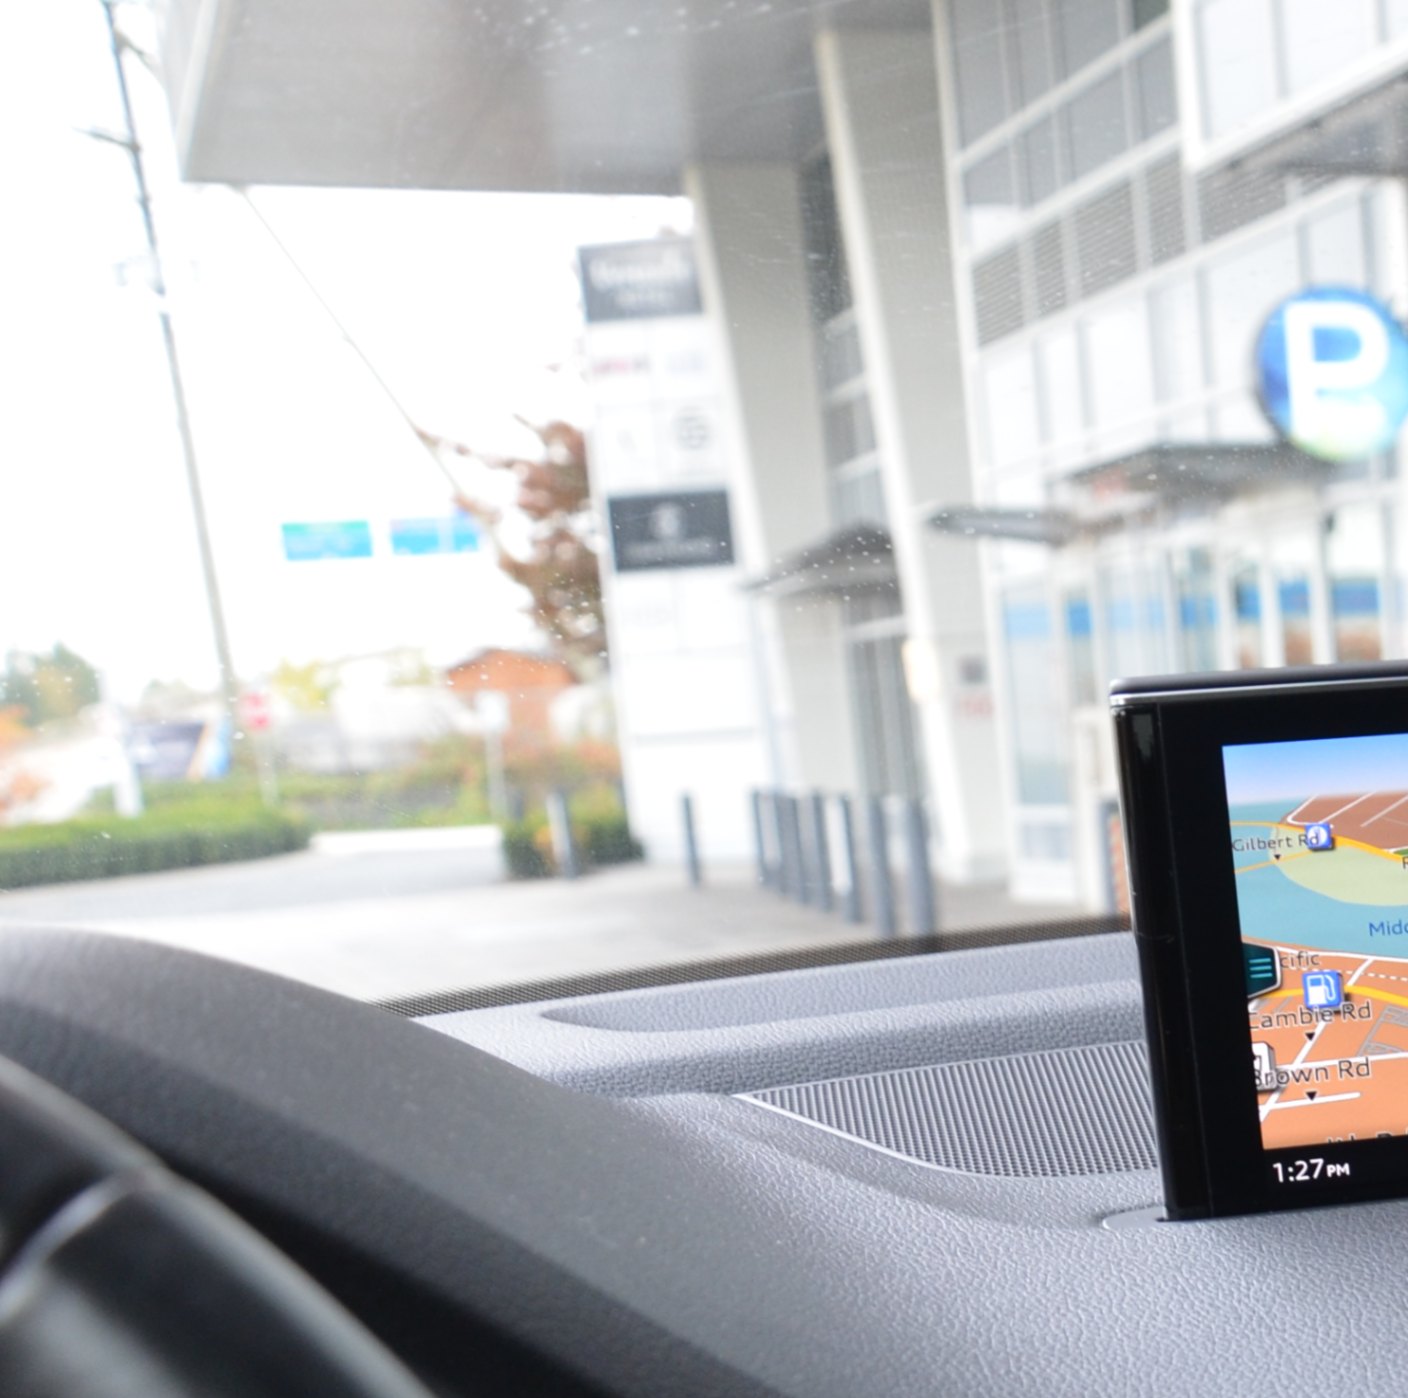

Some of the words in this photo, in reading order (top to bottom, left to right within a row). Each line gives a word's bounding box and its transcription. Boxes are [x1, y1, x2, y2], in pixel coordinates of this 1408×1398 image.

[1283, 298, 1392, 443] P
[1232, 836, 1293, 852] Gilbert
[1298, 833, 1320, 847] Rd
[1342, 1001, 1371, 1020] Rd
[1338, 1056, 1370, 1079] Rd
